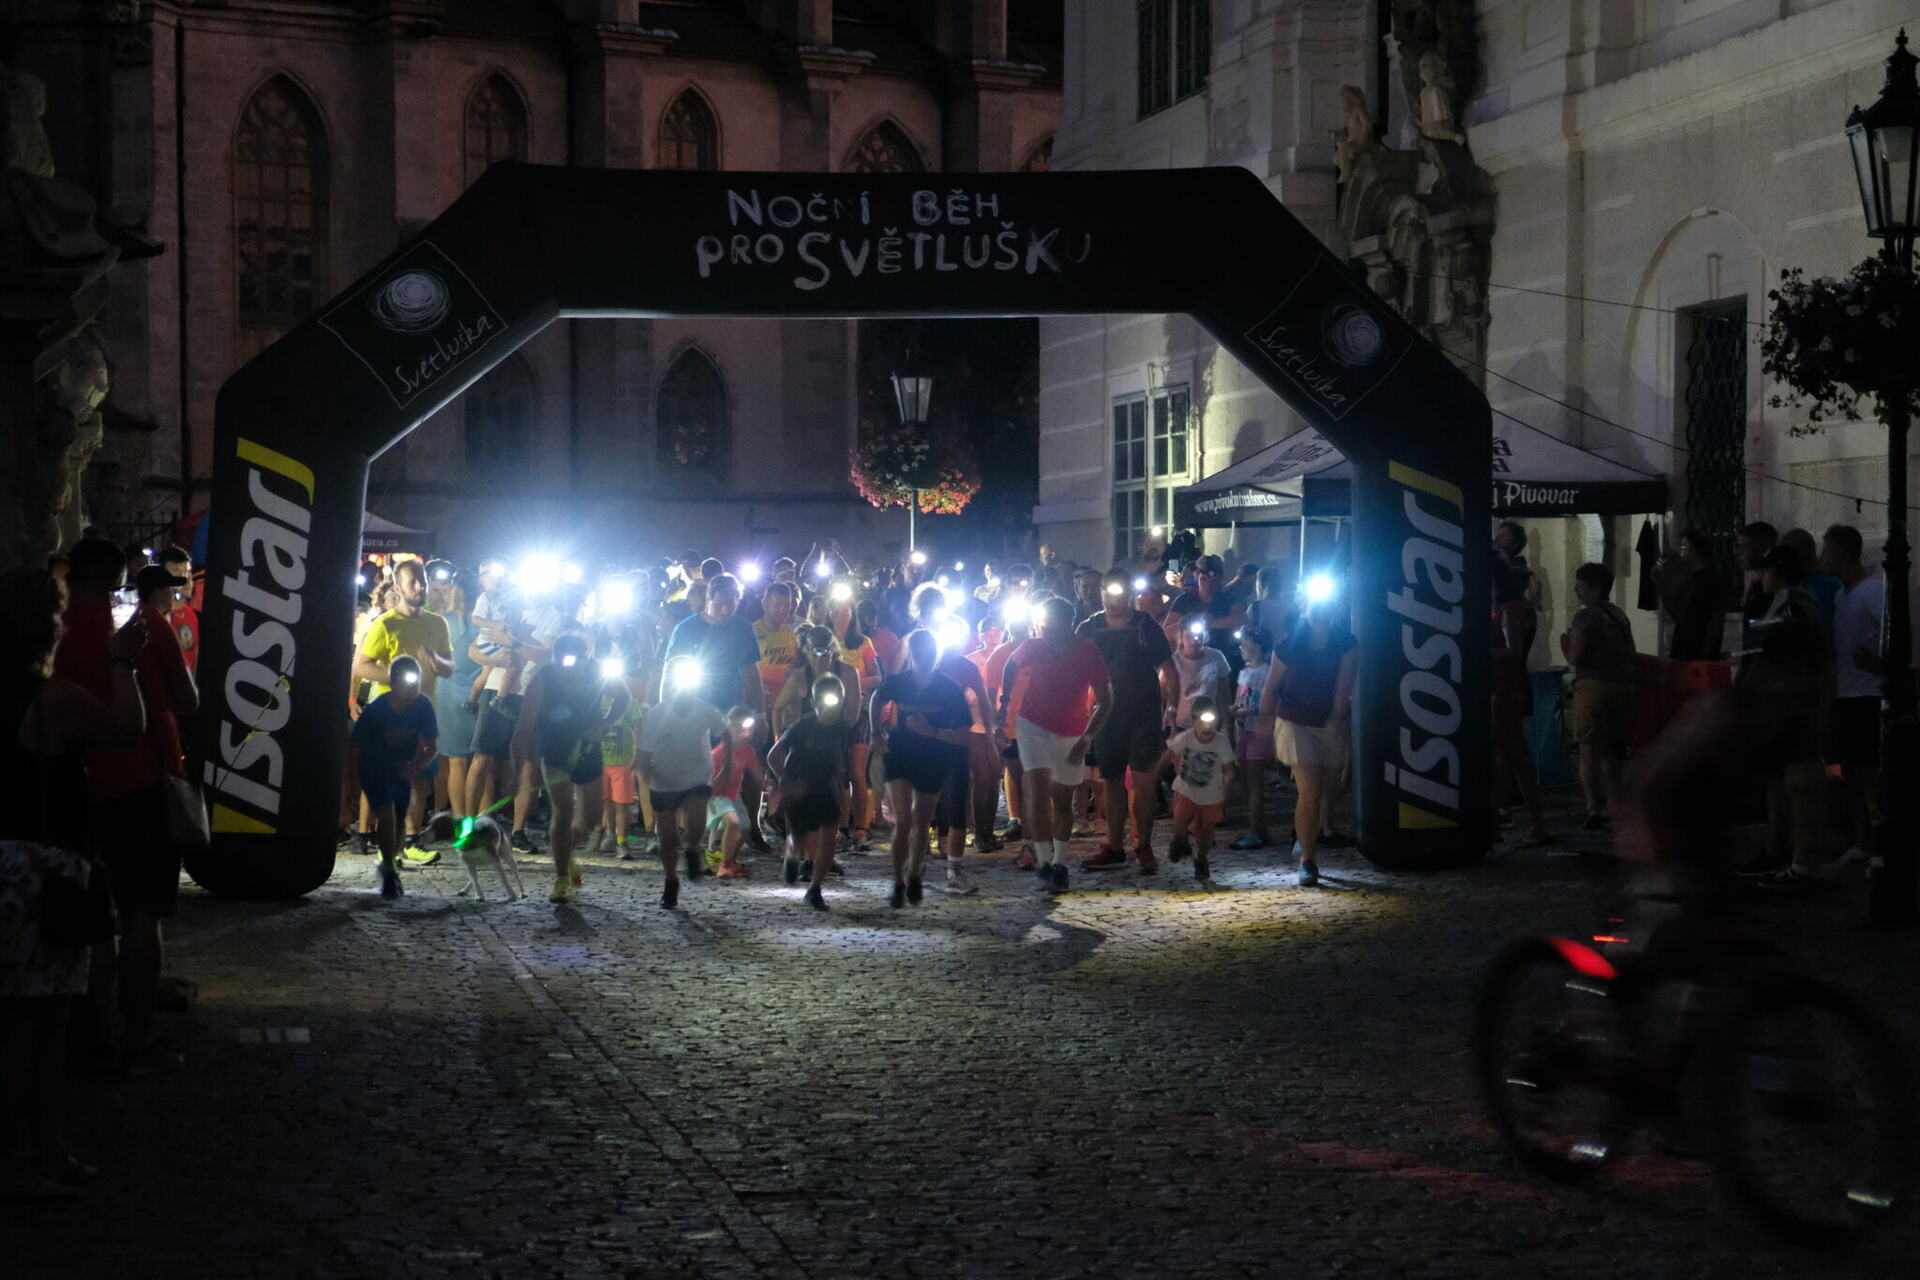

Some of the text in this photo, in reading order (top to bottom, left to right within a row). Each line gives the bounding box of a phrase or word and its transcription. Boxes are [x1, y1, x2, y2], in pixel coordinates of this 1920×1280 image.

[727, 188, 999, 228] NOČNÍ BĚH
[696, 220, 1091, 290] PRO SVĚTLUŠKU
[1503, 480, 1581, 508] Pivovar
[203, 466, 313, 816] isostar
[1383, 489, 1465, 812] isostar
